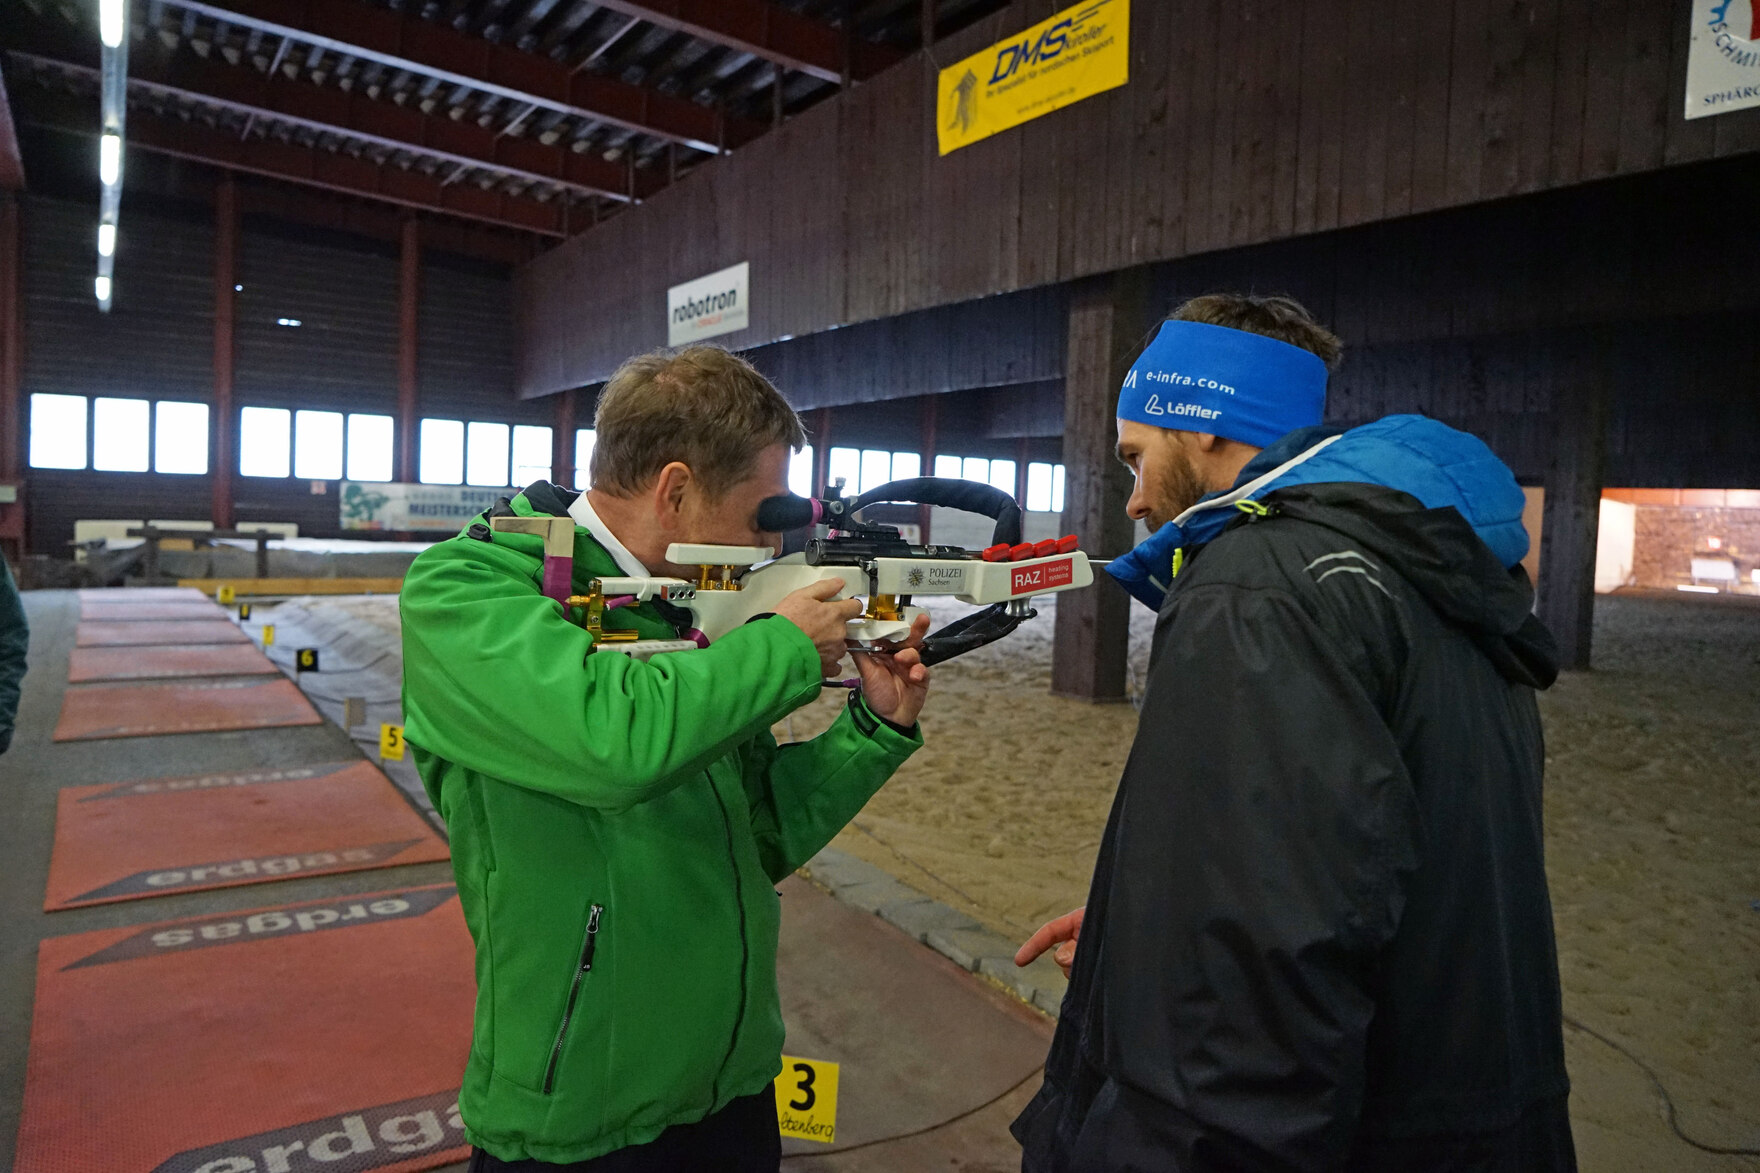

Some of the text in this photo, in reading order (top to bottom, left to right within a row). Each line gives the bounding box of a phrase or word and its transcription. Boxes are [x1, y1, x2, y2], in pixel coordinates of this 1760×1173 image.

[988, 18, 1072, 86] DMS
[1711, 22, 1760, 67] SCHMI
[673, 289, 737, 325] robotron
[1146, 370, 1235, 396] e-infra.com
[1167, 401, 1222, 420] Löffler
[409, 503, 484, 518] MEISTERSCH
[928, 578, 951, 586] Sachsen
[929, 567, 962, 578] POLIZEI
[1015, 563, 1069, 589] RAZ heating
[1048, 573, 1069, 583] systems
[301, 650, 314, 666] 6
[388, 727, 398, 748] 5
[144, 847, 375, 888] erdgas
[151, 897, 412, 948] erdgas
[789, 1062, 816, 1111] 3
[780, 1111, 834, 1143] ltenberg
